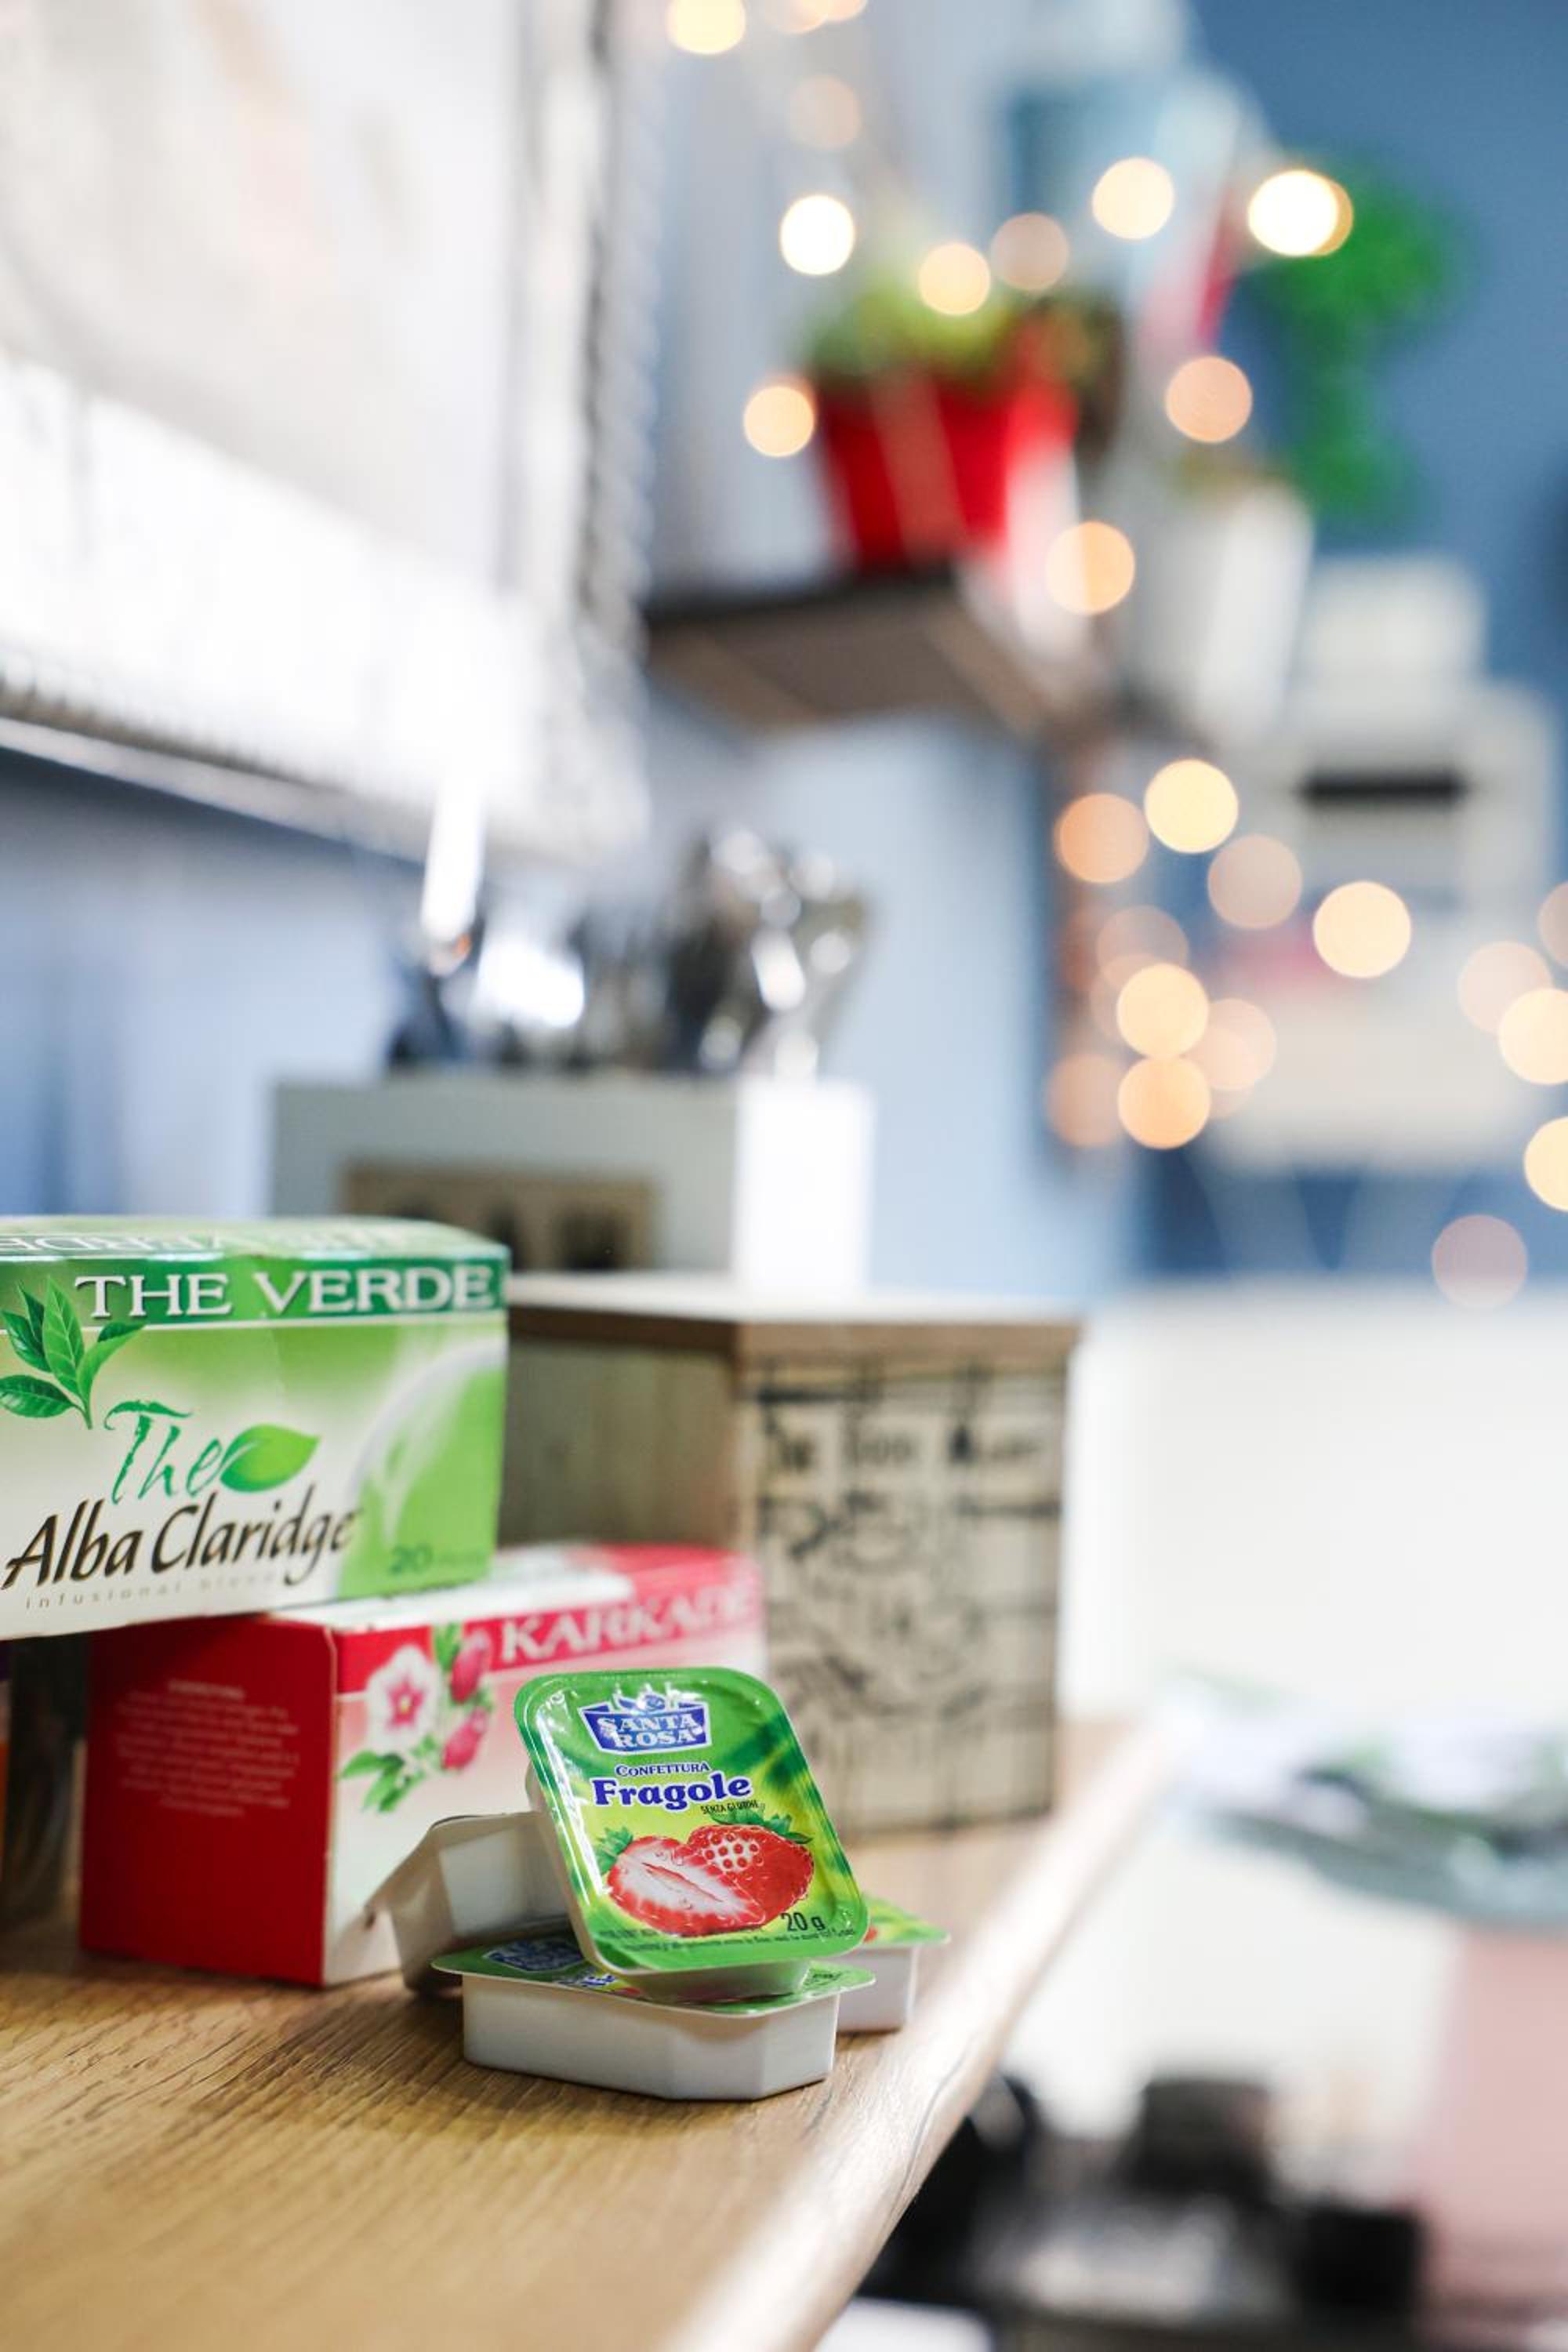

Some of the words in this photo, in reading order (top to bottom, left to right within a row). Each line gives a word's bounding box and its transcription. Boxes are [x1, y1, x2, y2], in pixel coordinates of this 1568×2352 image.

[74, 1273, 232, 1319] THE
[253, 1265, 495, 1315] VERDE
[1, 1498, 144, 1591] Alba
[151, 1483, 362, 1586] Claridge
[597, 1714, 696, 1734] SANTA
[615, 1729, 697, 1748] ROSA
[592, 1773, 751, 1811] Fragole
[781, 1912, 807, 1933] 20
[811, 1915, 827, 1932] g
